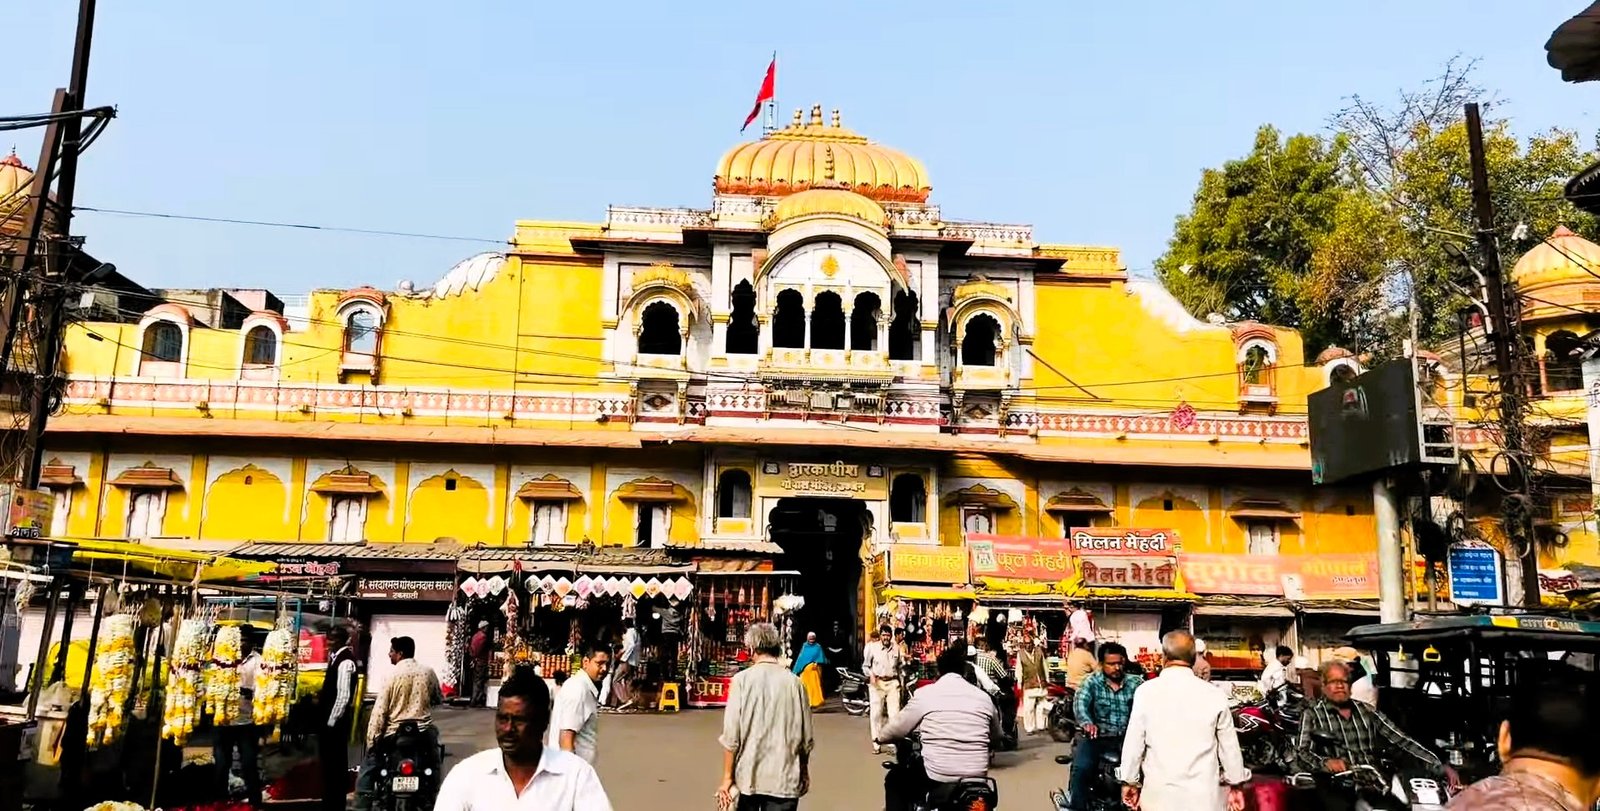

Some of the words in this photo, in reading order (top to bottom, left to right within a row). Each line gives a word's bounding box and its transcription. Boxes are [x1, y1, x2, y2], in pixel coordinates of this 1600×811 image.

[1074, 531, 1121, 550] मिलन
[1124, 532, 1167, 553] मेंहदी
[996, 553, 1027, 574] फूल
[1082, 561, 1127, 583] मिलन
[1131, 562, 1174, 585] मेंहदी
